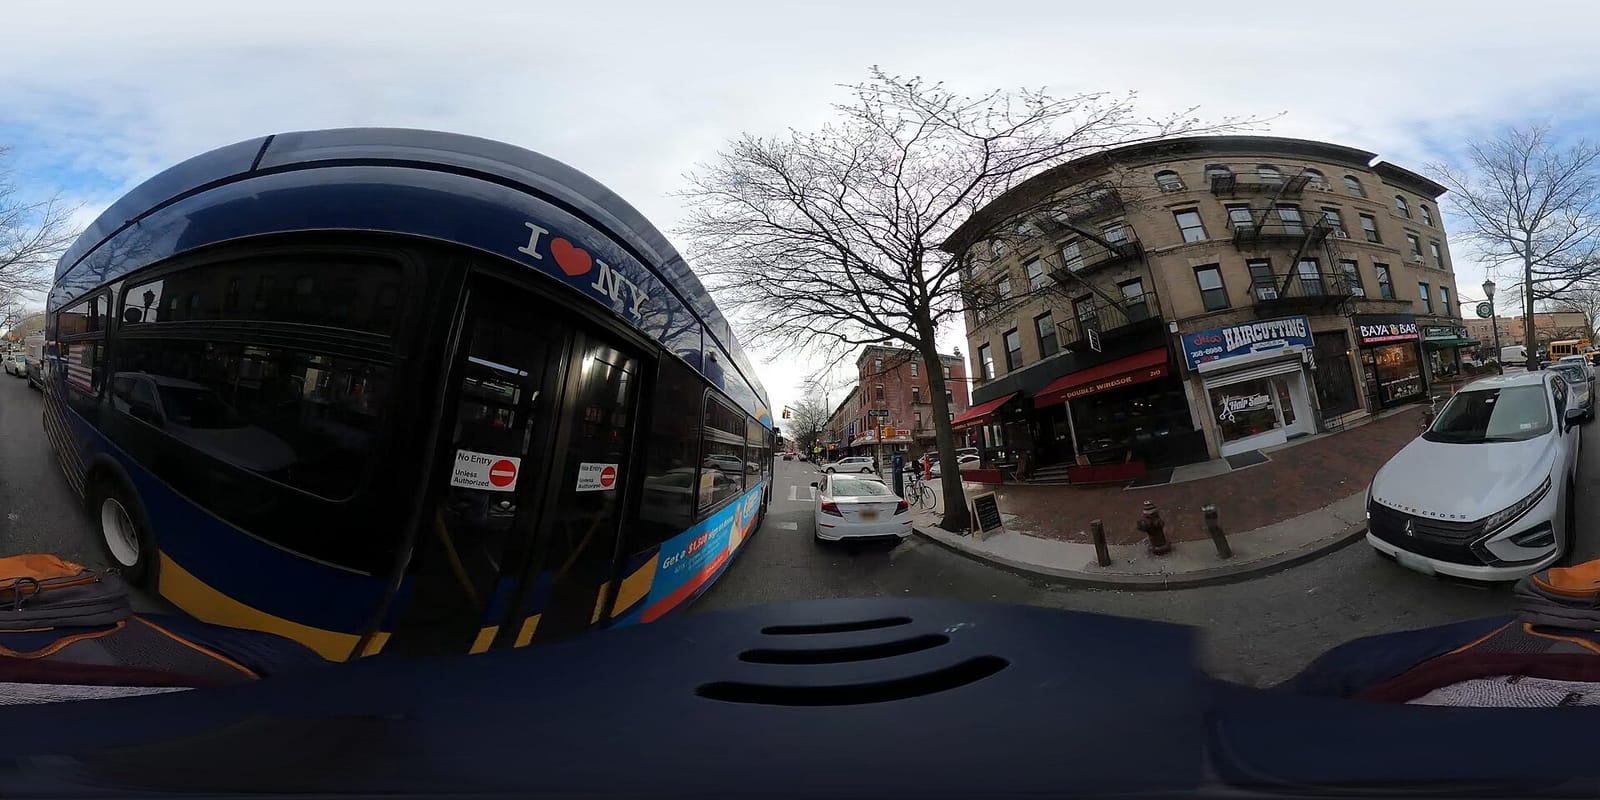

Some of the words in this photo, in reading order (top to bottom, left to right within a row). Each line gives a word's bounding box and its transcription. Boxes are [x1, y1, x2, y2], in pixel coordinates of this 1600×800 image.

[517, 221, 549, 260] I
[591, 258, 649, 320] NY
[1222, 318, 1307, 353] HAIRCUTTING
[1360, 324, 1390, 337] BAYA
[1399, 323, 1418, 334] BAR
[1066, 386, 1095, 399] DOUBLE
[1096, 376, 1132, 391] WINDSOR
[1228, 398, 1249, 411] Hair
[458, 452, 470, 461] No
[471, 454, 493, 466] Entry
[455, 469, 477, 478] Unless
[453, 476, 490, 487] Authorized
[1378, 497, 1417, 513] ECLIPSE
[1422, 510, 1467, 520] CROSS
[662, 552, 680, 569] Get
